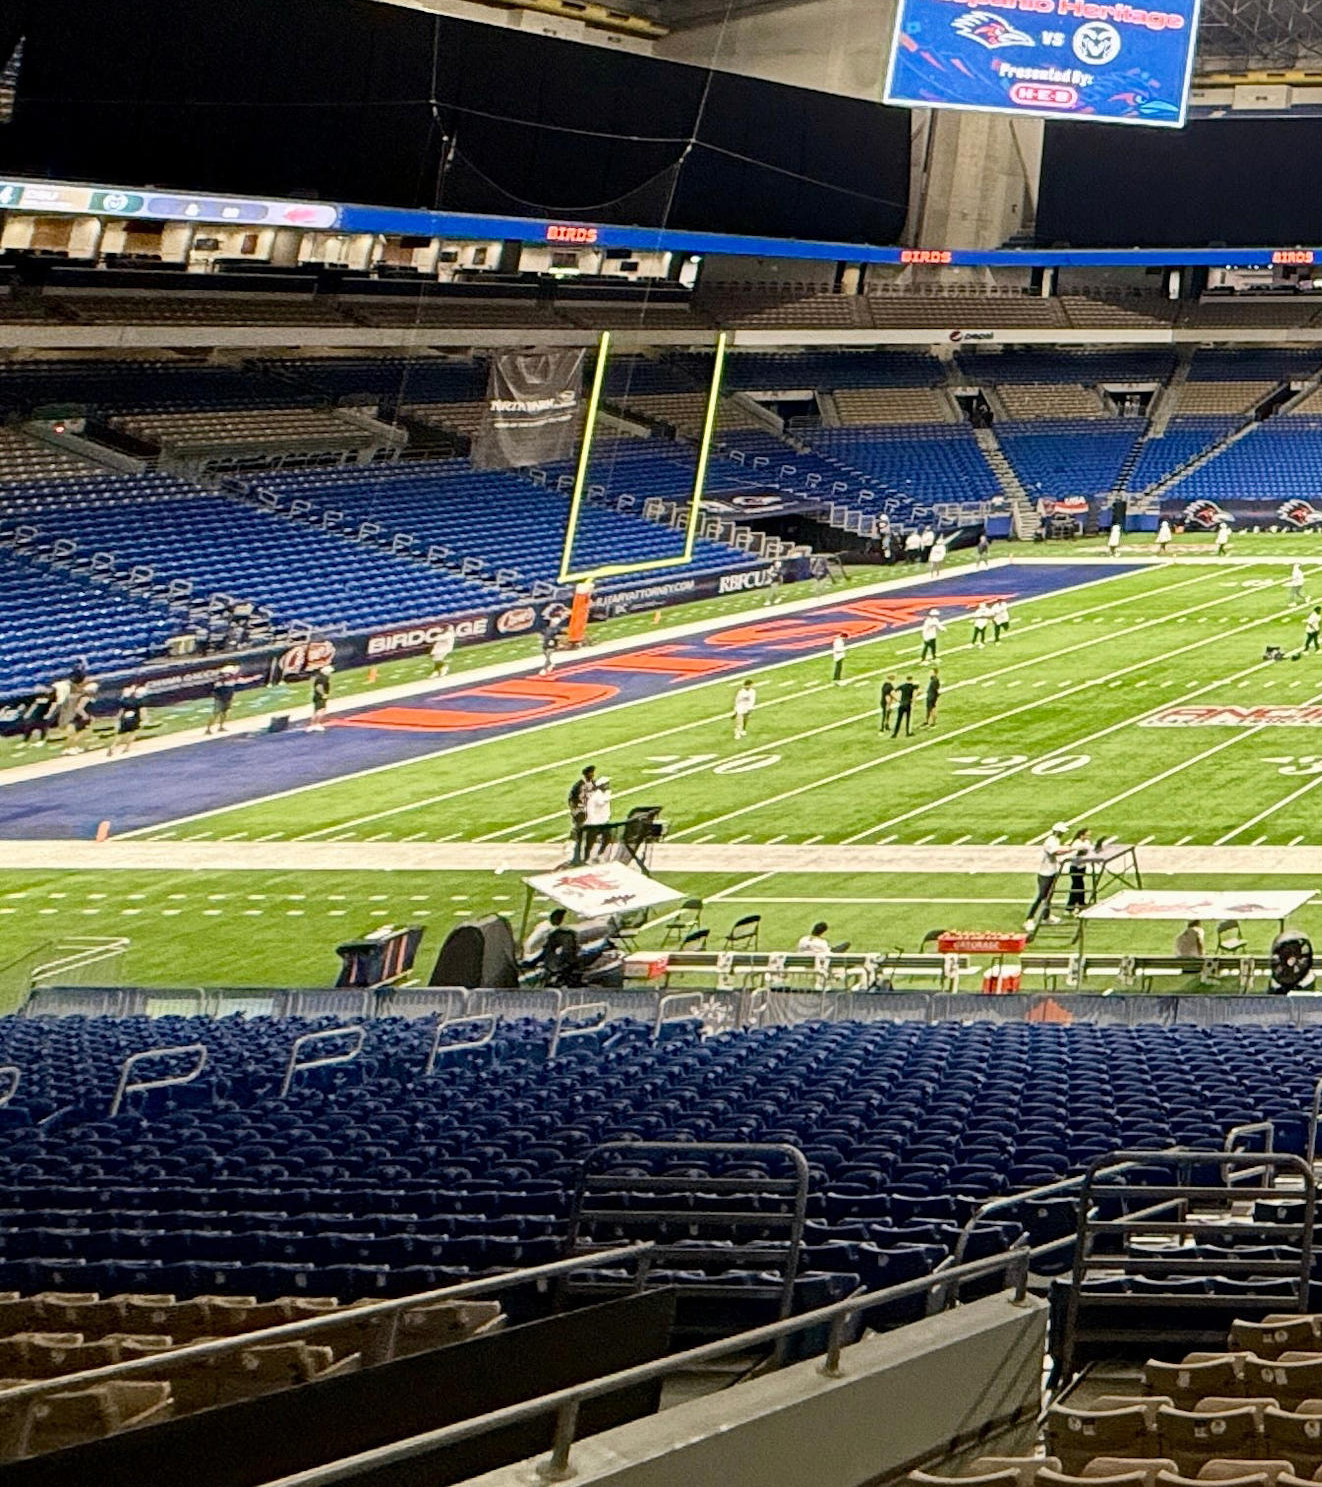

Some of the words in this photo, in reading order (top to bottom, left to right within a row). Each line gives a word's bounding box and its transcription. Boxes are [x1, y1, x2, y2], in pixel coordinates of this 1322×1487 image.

[999, 62, 1070, 83] Presented
[547, 225, 597, 243] BIRDS
[901, 250, 952, 264] BIRDS
[1272, 250, 1314, 264] BIRDS
[324, 594, 1016, 733] UTSA
